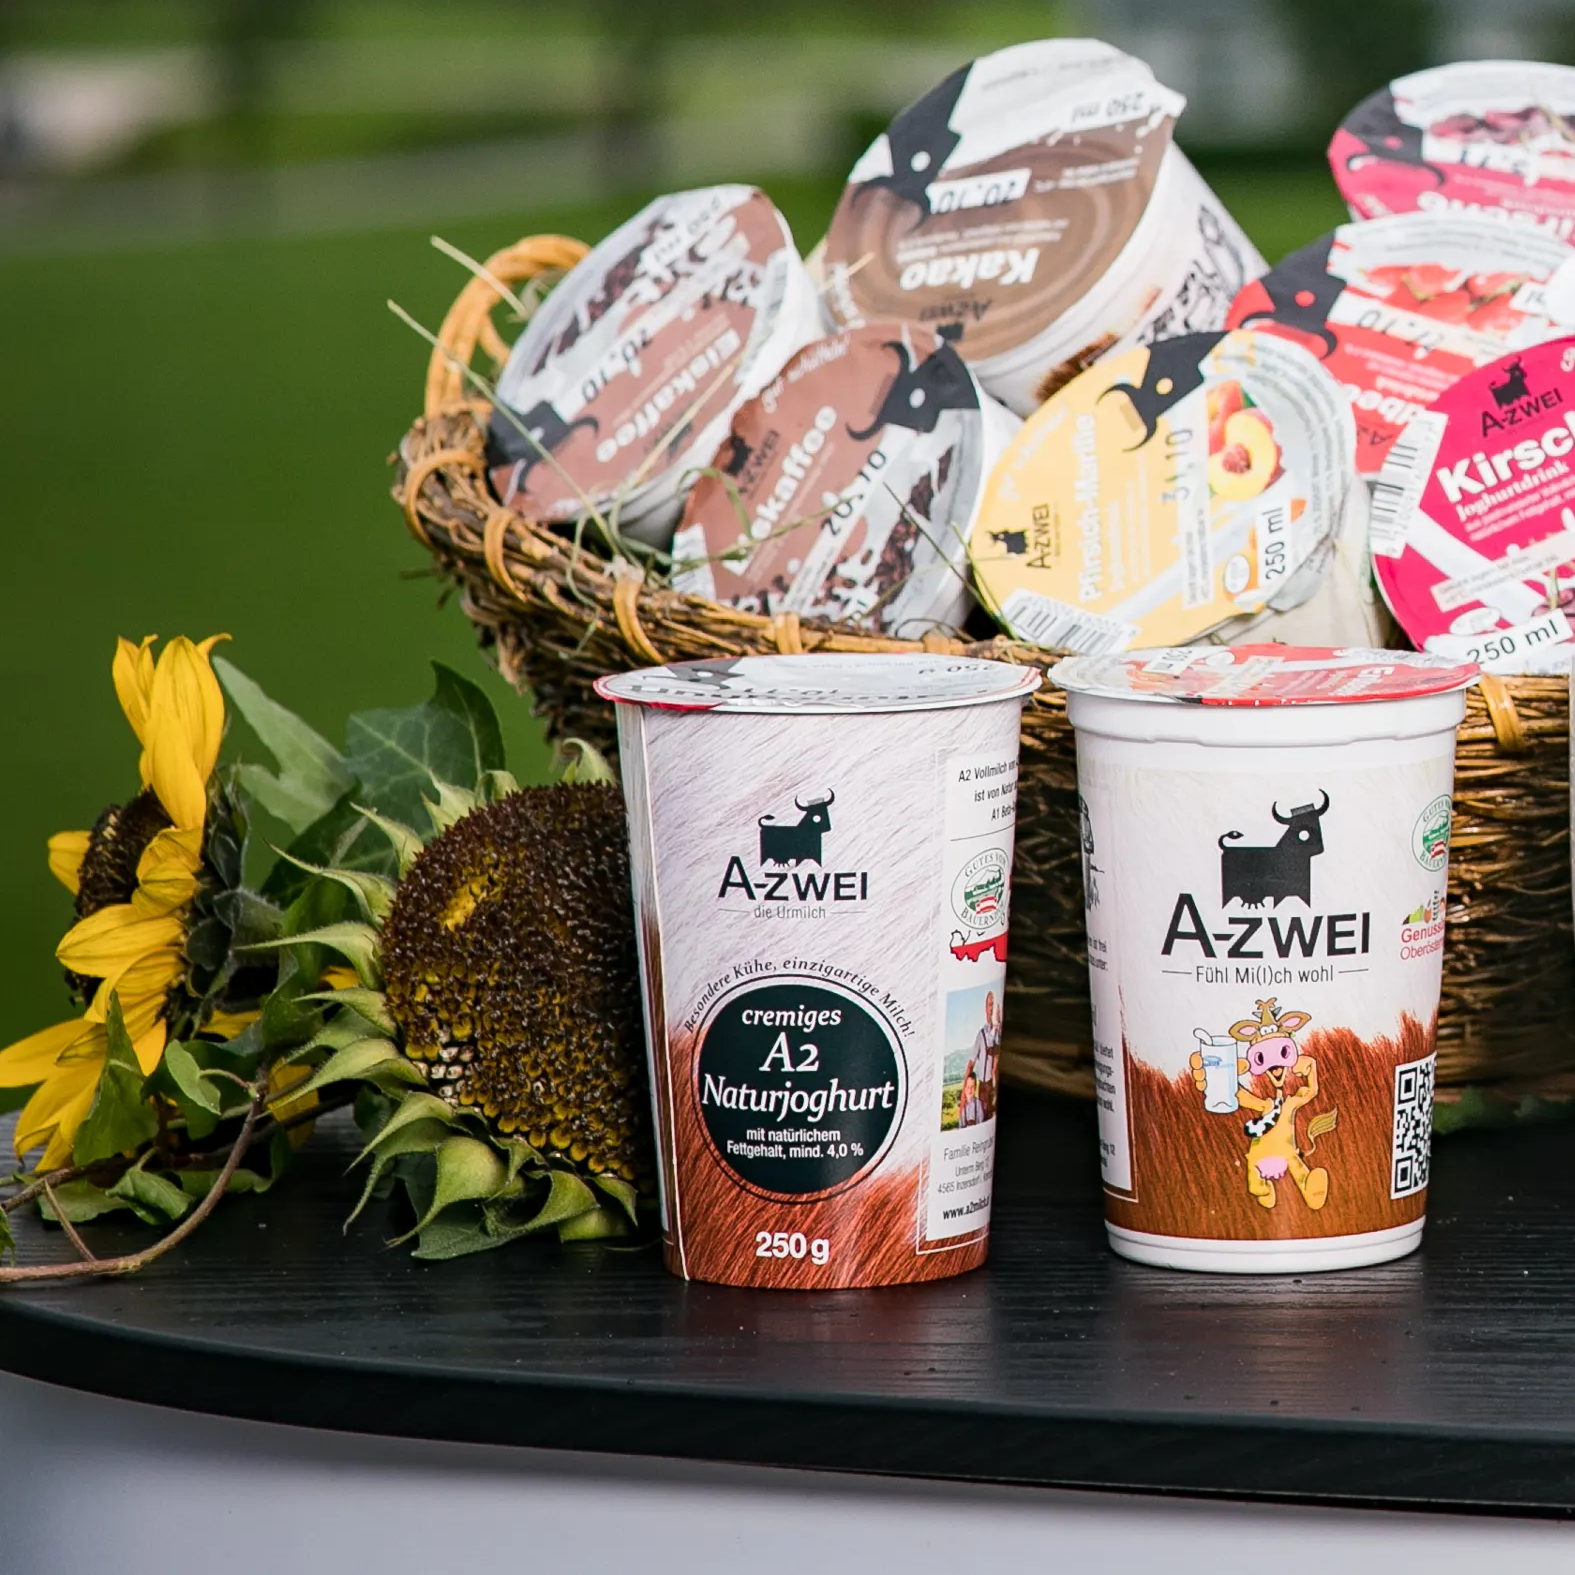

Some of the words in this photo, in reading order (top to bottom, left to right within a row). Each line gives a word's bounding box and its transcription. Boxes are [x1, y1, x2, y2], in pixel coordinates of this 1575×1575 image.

[900, 248, 1039, 290] Kakao
[596, 328, 741, 463] Eiskaffee
[1481, 387, 1563, 438] A-ZWEI
[821, 450, 887, 536] 20.10
[1456, 459, 1570, 522] Joghurtdrink
[1026, 503, 1052, 571] A-ZWEI
[1261, 506, 1285, 535] ml
[1264, 537, 1287, 581] 250
[1466, 635, 1517, 667] 250
[1525, 619, 1560, 648] ml
[958, 769, 973, 783] A2
[974, 762, 1008, 780] Vollmilch
[974, 789, 986, 802] ist
[987, 785, 1000, 800] von
[717, 855, 868, 902] A-ZWEI
[964, 852, 995, 878] GUTES
[753, 904, 773, 919] die
[776, 904, 827, 920] Urmilch
[1161, 892, 1371, 959] A-ZWEI
[1195, 964, 1229, 985] Fühl
[1234, 964, 1293, 987] Mi(l)ch
[1297, 964, 1335, 984] wohl
[684, 972, 731, 1034] Besondere
[732, 958, 778, 980] Kühe,
[782, 956, 881, 997] einzigartige
[878, 993, 917, 1038] Milch!
[741, 1004, 842, 1033] cremiges
[758, 1031, 820, 1073] A2
[701, 1073, 896, 1123] Naturjoghurt
[726, 1140, 786, 1160] Fettgehalt,
[788, 1143, 825, 1158] mind.
[826, 1143, 848, 1159] 4,0
[850, 1141, 864, 1157] %
[746, 1129, 766, 1141] mit
[767, 1128, 841, 1142] natürlichem
[943, 1144, 971, 1162] Familie
[756, 1231, 808, 1262] 250
[811, 1237, 831, 1266] g
